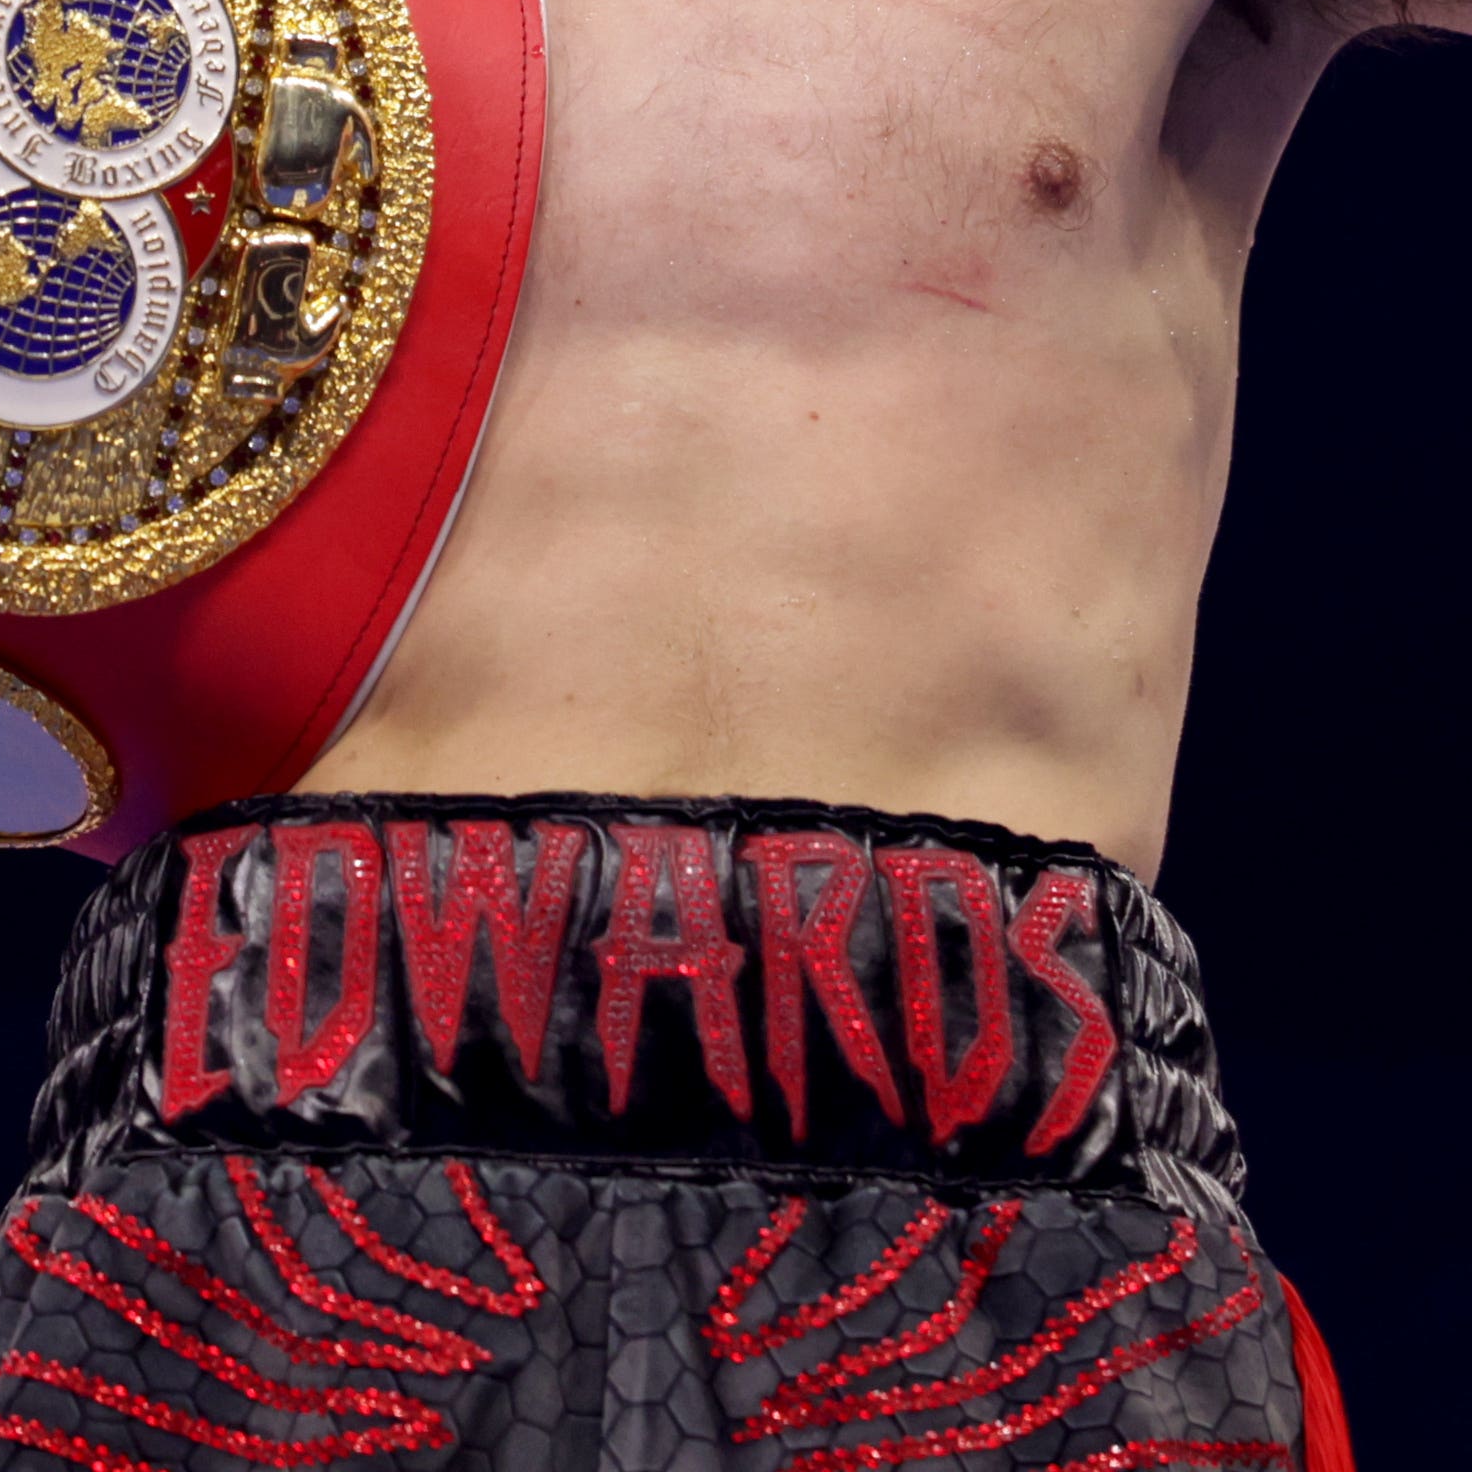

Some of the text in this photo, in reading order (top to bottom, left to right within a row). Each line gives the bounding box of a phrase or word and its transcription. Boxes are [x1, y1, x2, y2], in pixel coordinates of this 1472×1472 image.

[62, 127, 205, 187] Boxing
[94, 209, 177, 395] Champion
[159, 818, 1120, 1158] EDWARDS
